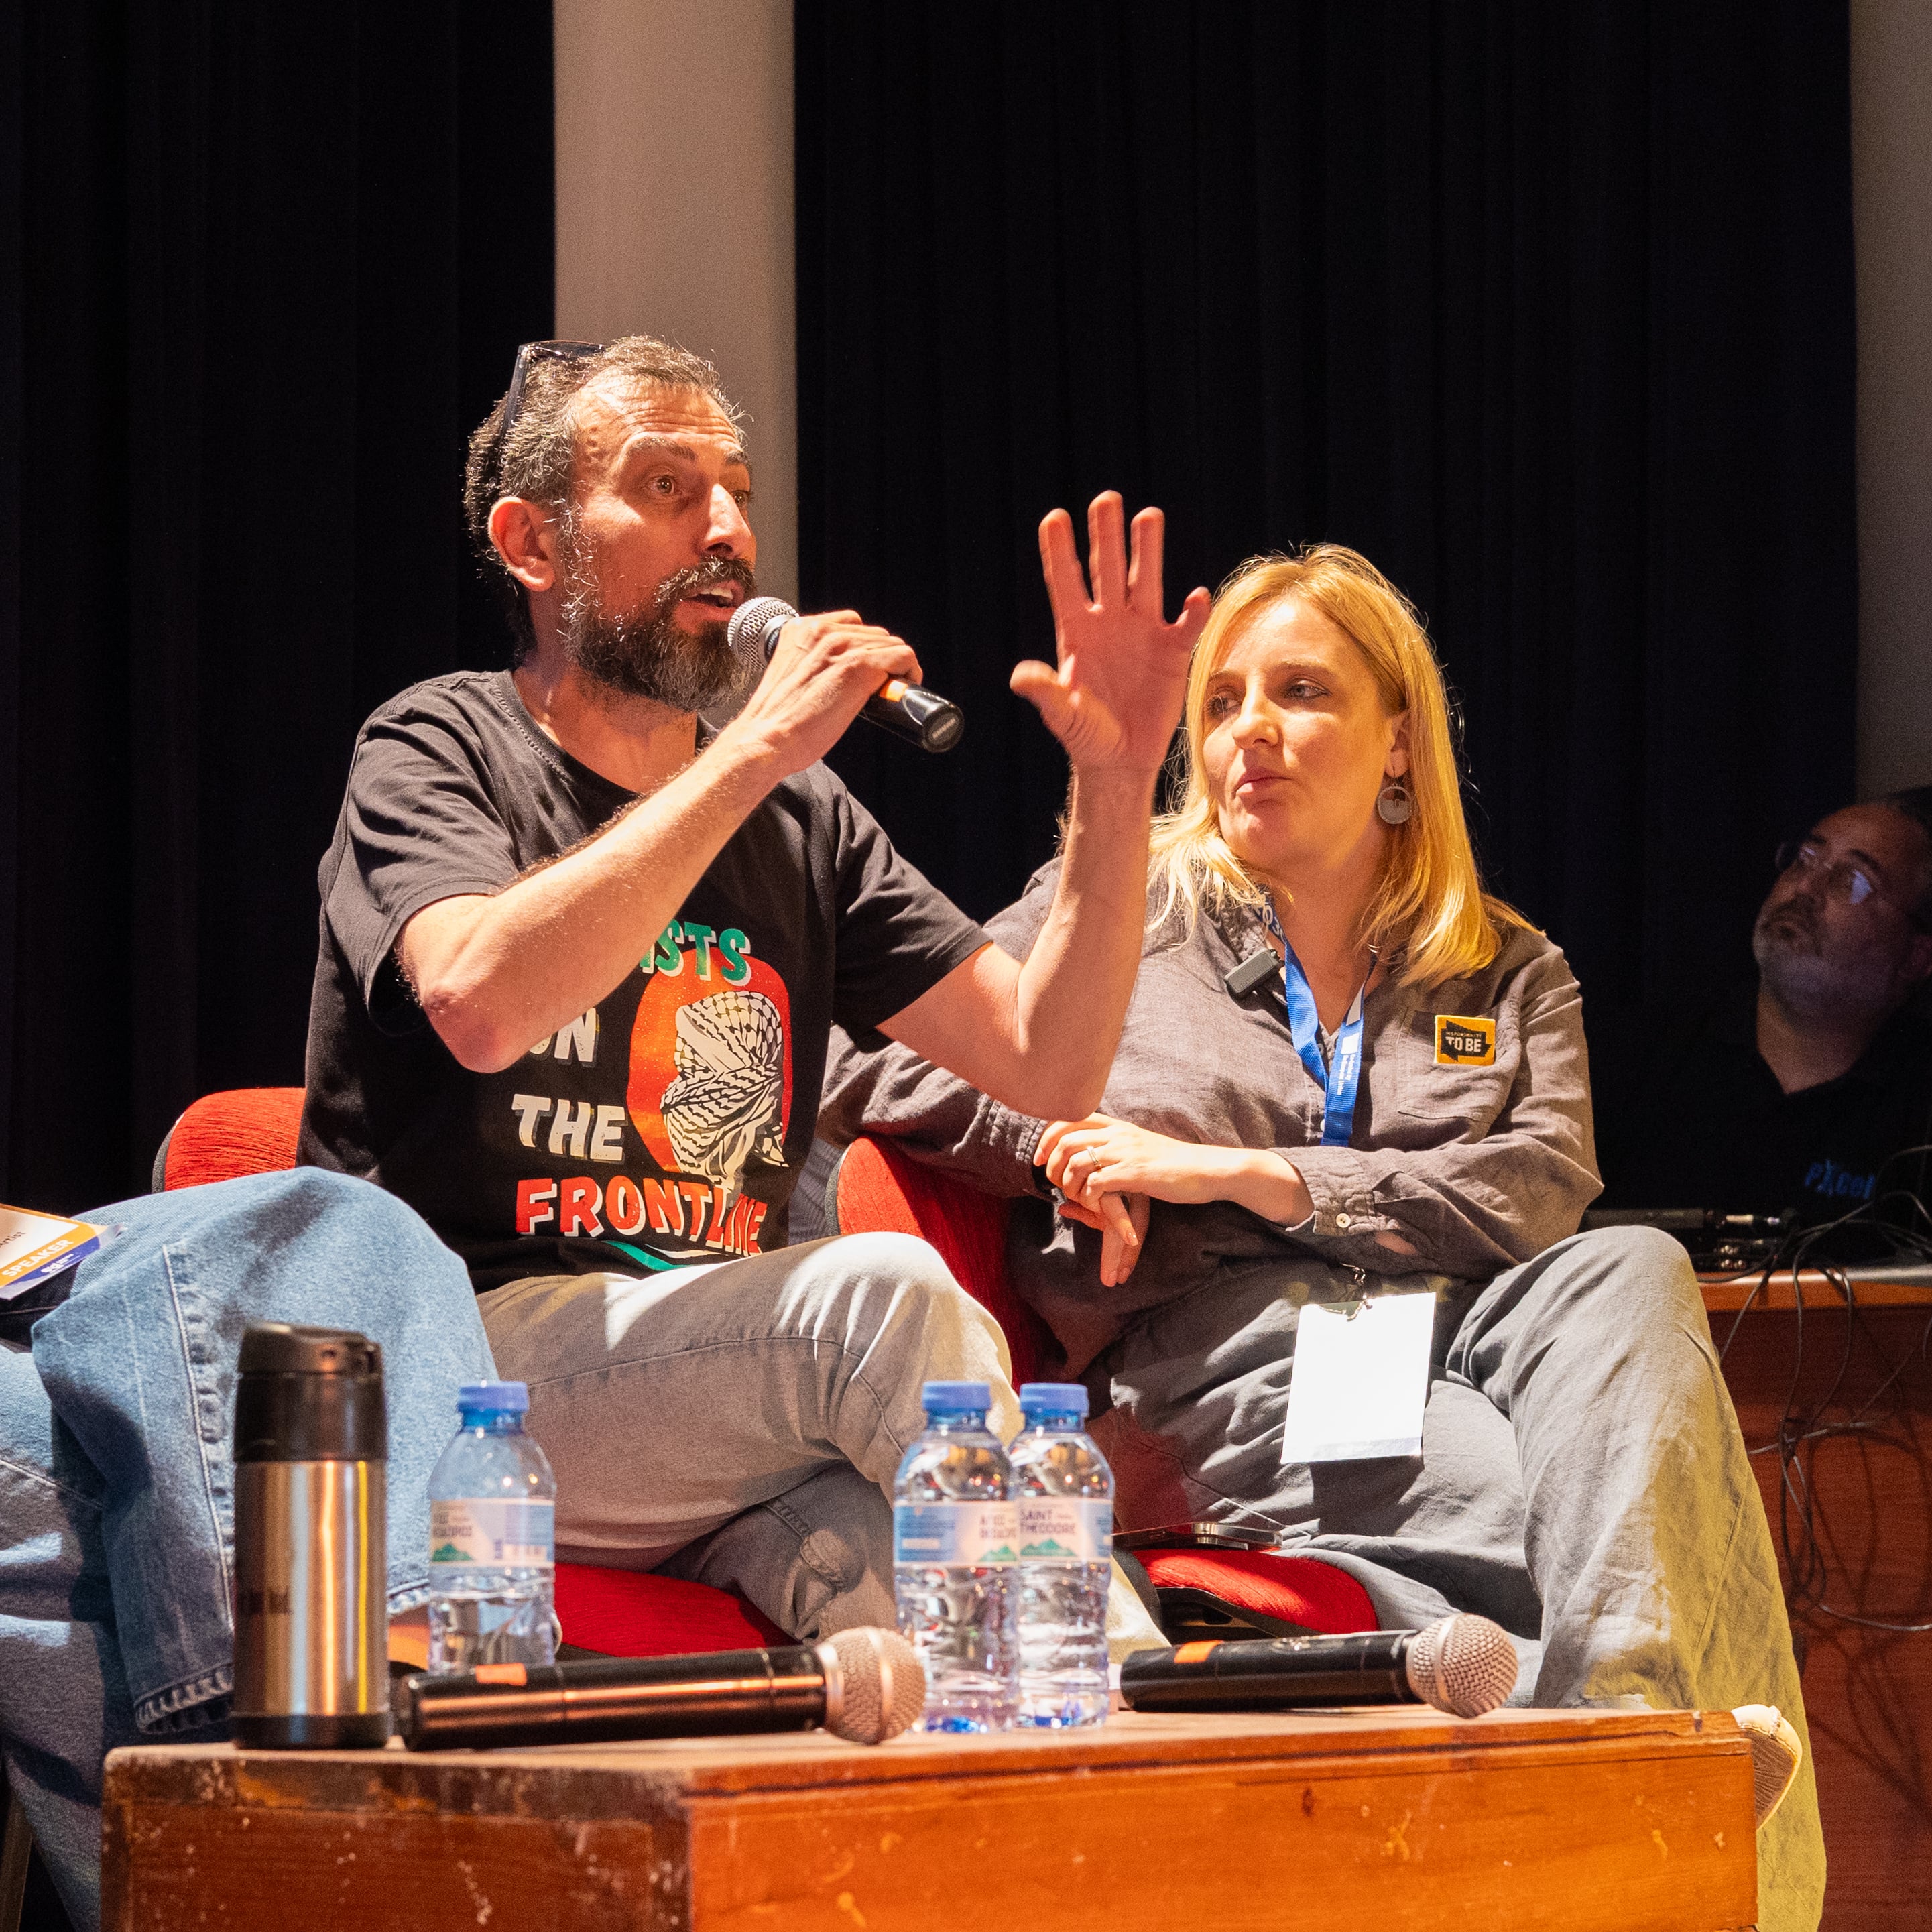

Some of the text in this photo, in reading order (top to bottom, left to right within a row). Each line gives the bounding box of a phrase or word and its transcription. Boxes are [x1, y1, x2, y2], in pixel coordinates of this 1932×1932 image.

[529, 1007, 599, 1067] N
[1445, 1036, 1482, 1052] TO BE
[511, 1094, 626, 1163] THE
[516, 1175, 768, 1256] FRONTLINE
[2, 1240, 74, 1276] SPEAKER
